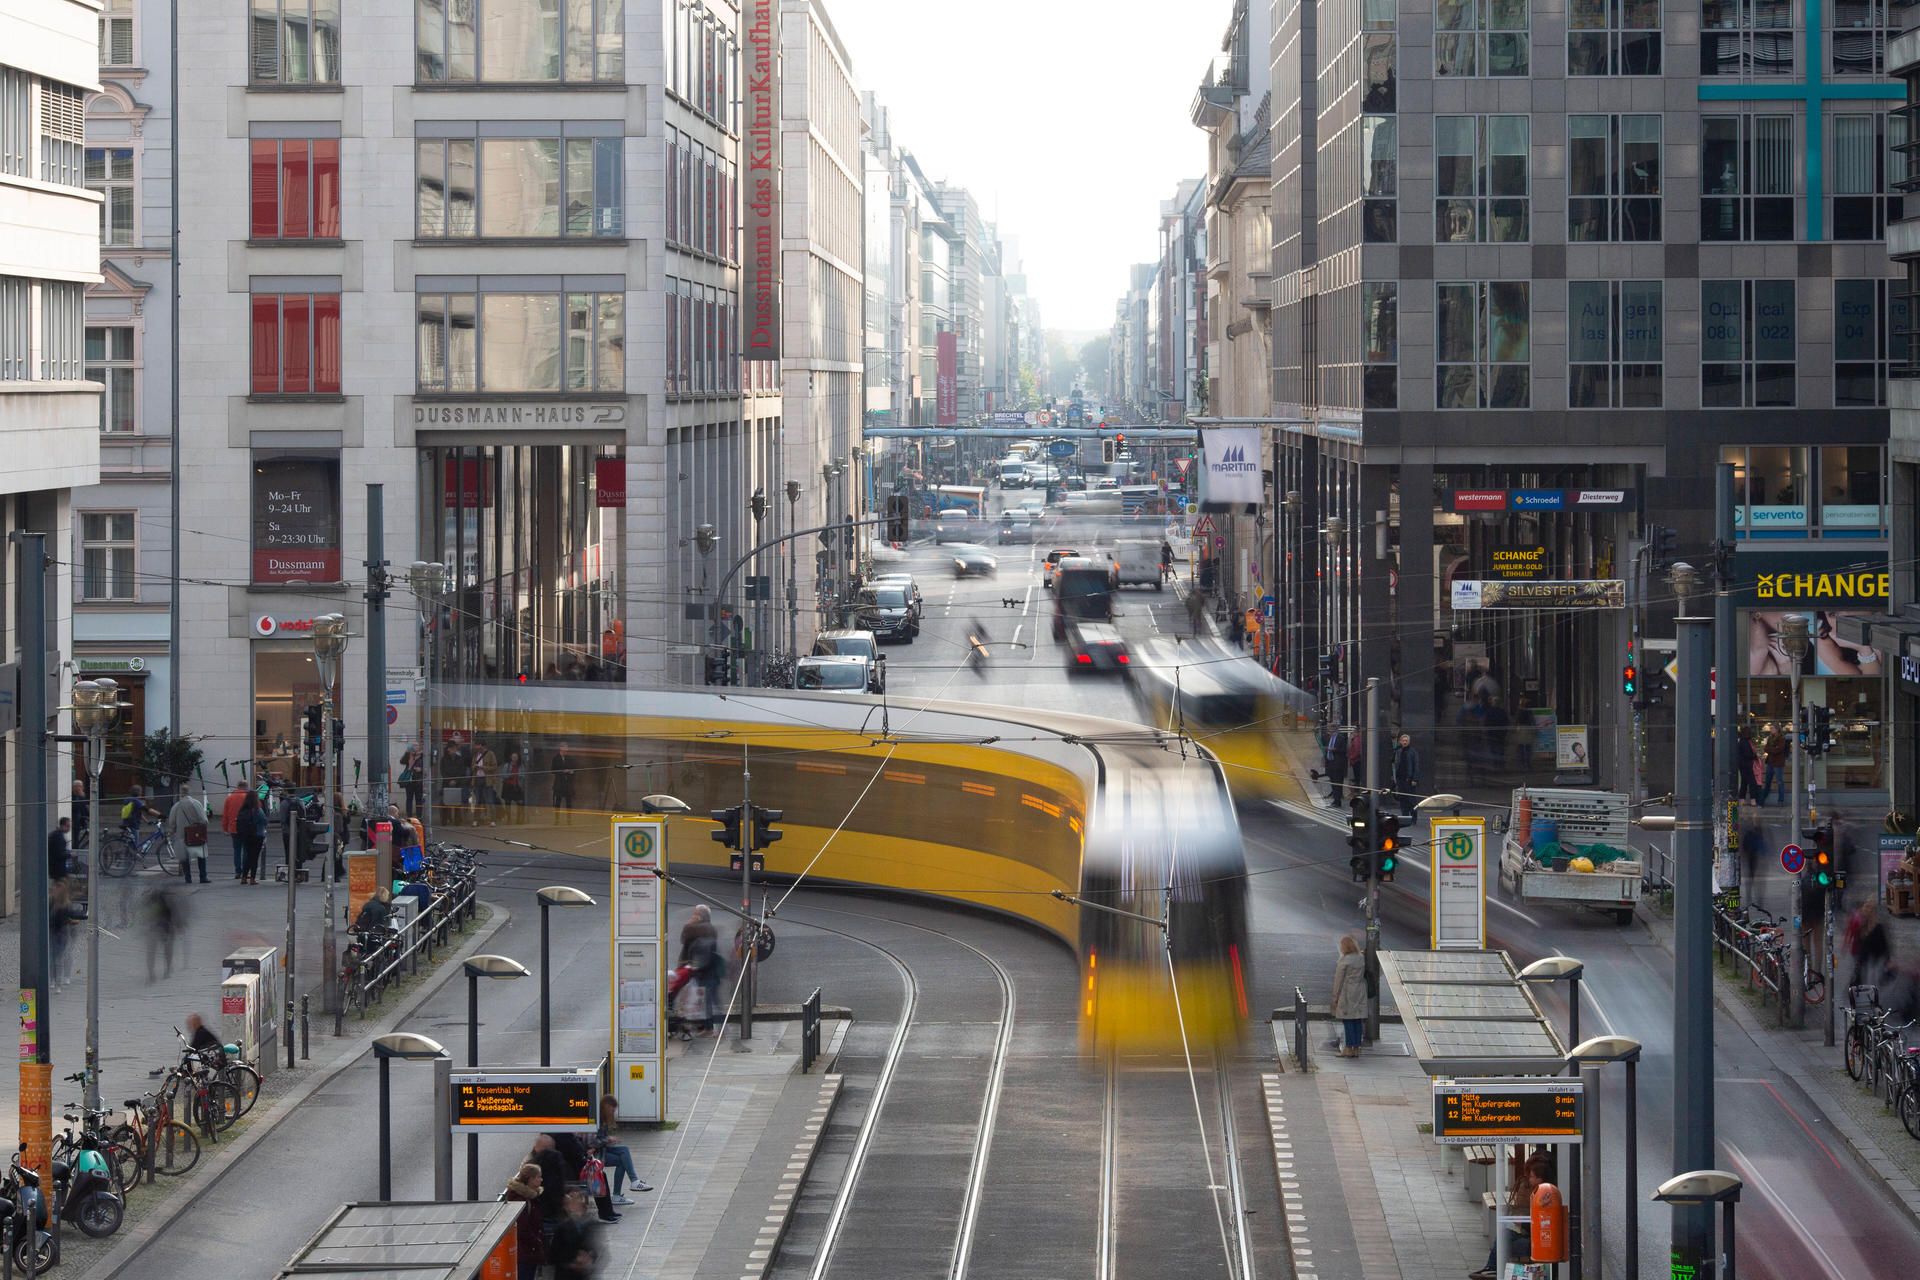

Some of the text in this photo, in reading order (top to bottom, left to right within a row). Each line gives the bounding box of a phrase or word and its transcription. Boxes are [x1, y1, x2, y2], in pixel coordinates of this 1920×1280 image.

[750, 178, 772, 218] das
[750, 225, 772, 349] Dussmann
[414, 407, 586, 424] DUSSMANN-HAUS
[1211, 462, 1257, 473] MARITIM
[1458, 494, 1502, 502] westermann
[1525, 496, 1560, 504] Schroedel
[1582, 493, 1619, 502] Diesterweg
[294, 504, 312, 513] Uhr
[1752, 510, 1804, 520] servento
[268, 521, 281, 531] Sa
[307, 534, 326, 544] Uhr
[269, 559, 326, 569] Dussmann
[1508, 585, 1577, 597] SILVESTER
[80, 660, 129, 670] Dussmann
[462, 1086, 531, 1094] M1 Rosenthal Nord
[463, 1100, 474, 1108] 12
[1447, 1093, 1575, 1105] M1 Mitte 8 min
[476, 1103, 524, 1111] Pasedagplatz
[1461, 1100, 1521, 1109] Am Kupfergraben
[1448, 1107, 1575, 1119] 12 Mitte 9 min
[1474, 1114, 1521, 1122] Kupfergraben
